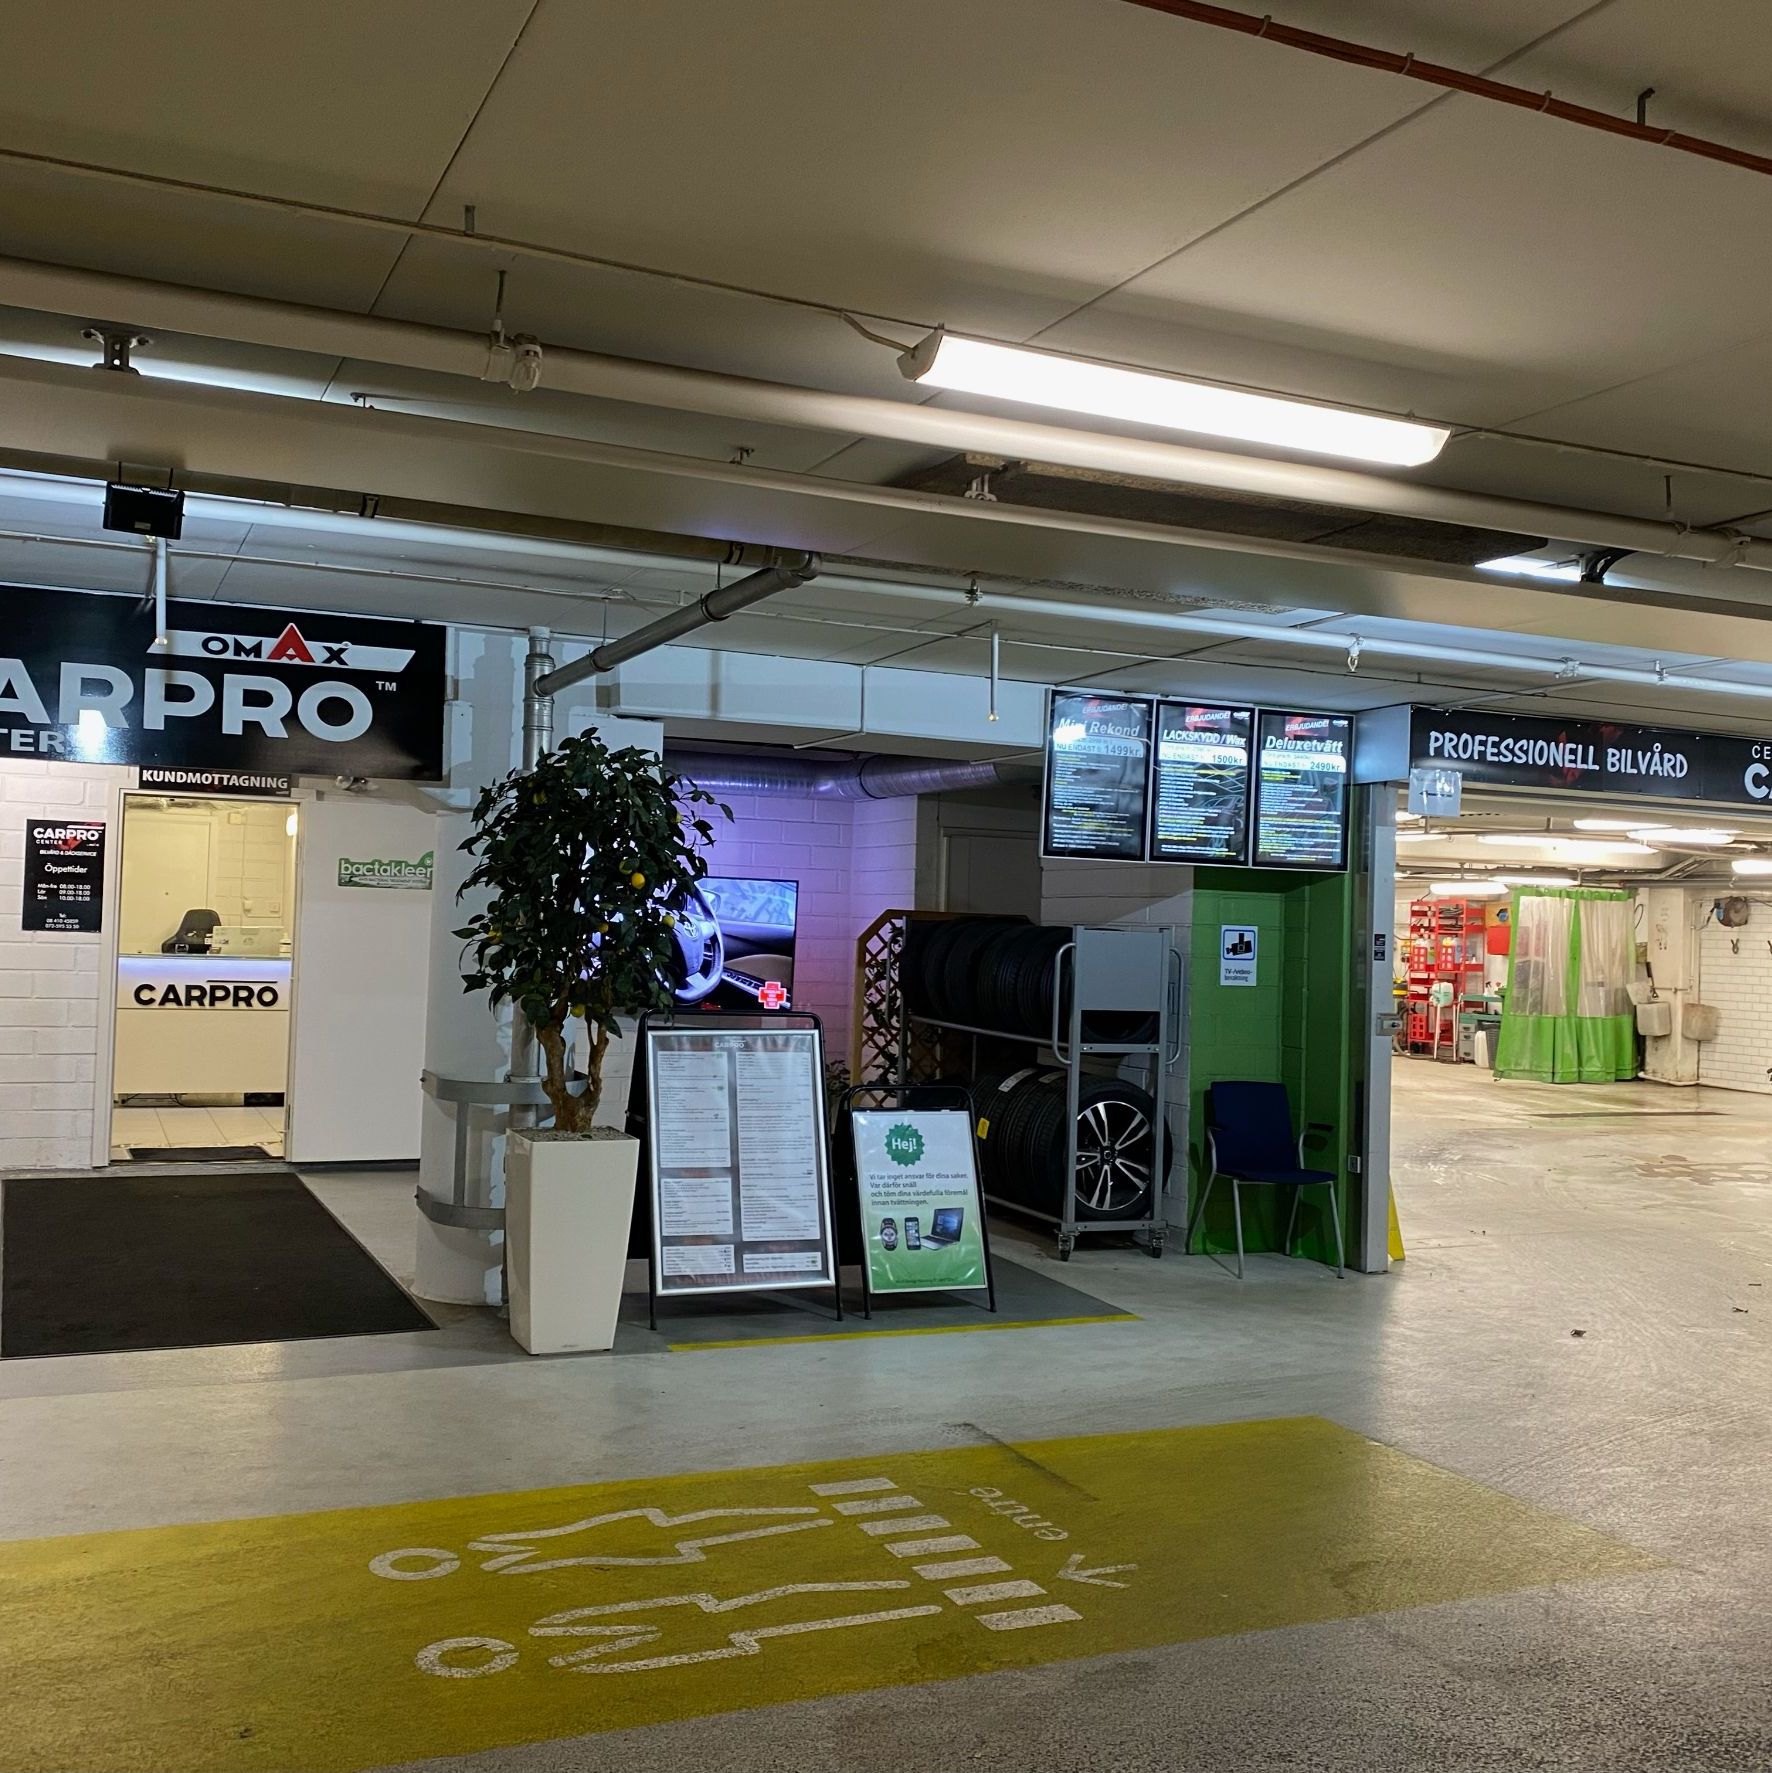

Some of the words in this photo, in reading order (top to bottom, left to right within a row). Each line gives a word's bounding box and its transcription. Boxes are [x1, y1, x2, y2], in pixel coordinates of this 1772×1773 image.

[201, 623, 349, 666] OMAX
[1089, 721, 1141, 737] Rekond
[1162, 729, 1220, 744] LACKSKYDD
[1226, 734, 1247, 746] Wax
[1265, 735, 1344, 753] Deluxetvätt
[1429, 731, 1600, 771] PROFESSIONELL
[1606, 742, 1689, 778] BILVÅRD
[142, 769, 288, 789] KUNDMOTTAGNING
[33, 828, 99, 841] CARPRO
[44, 862, 88, 874] Öppettider
[341, 860, 433, 878] bactakleer
[134, 983, 279, 1007] CARPRO
[891, 1138, 917, 1152] Hej!
[887, 1173, 903, 1181] inget
